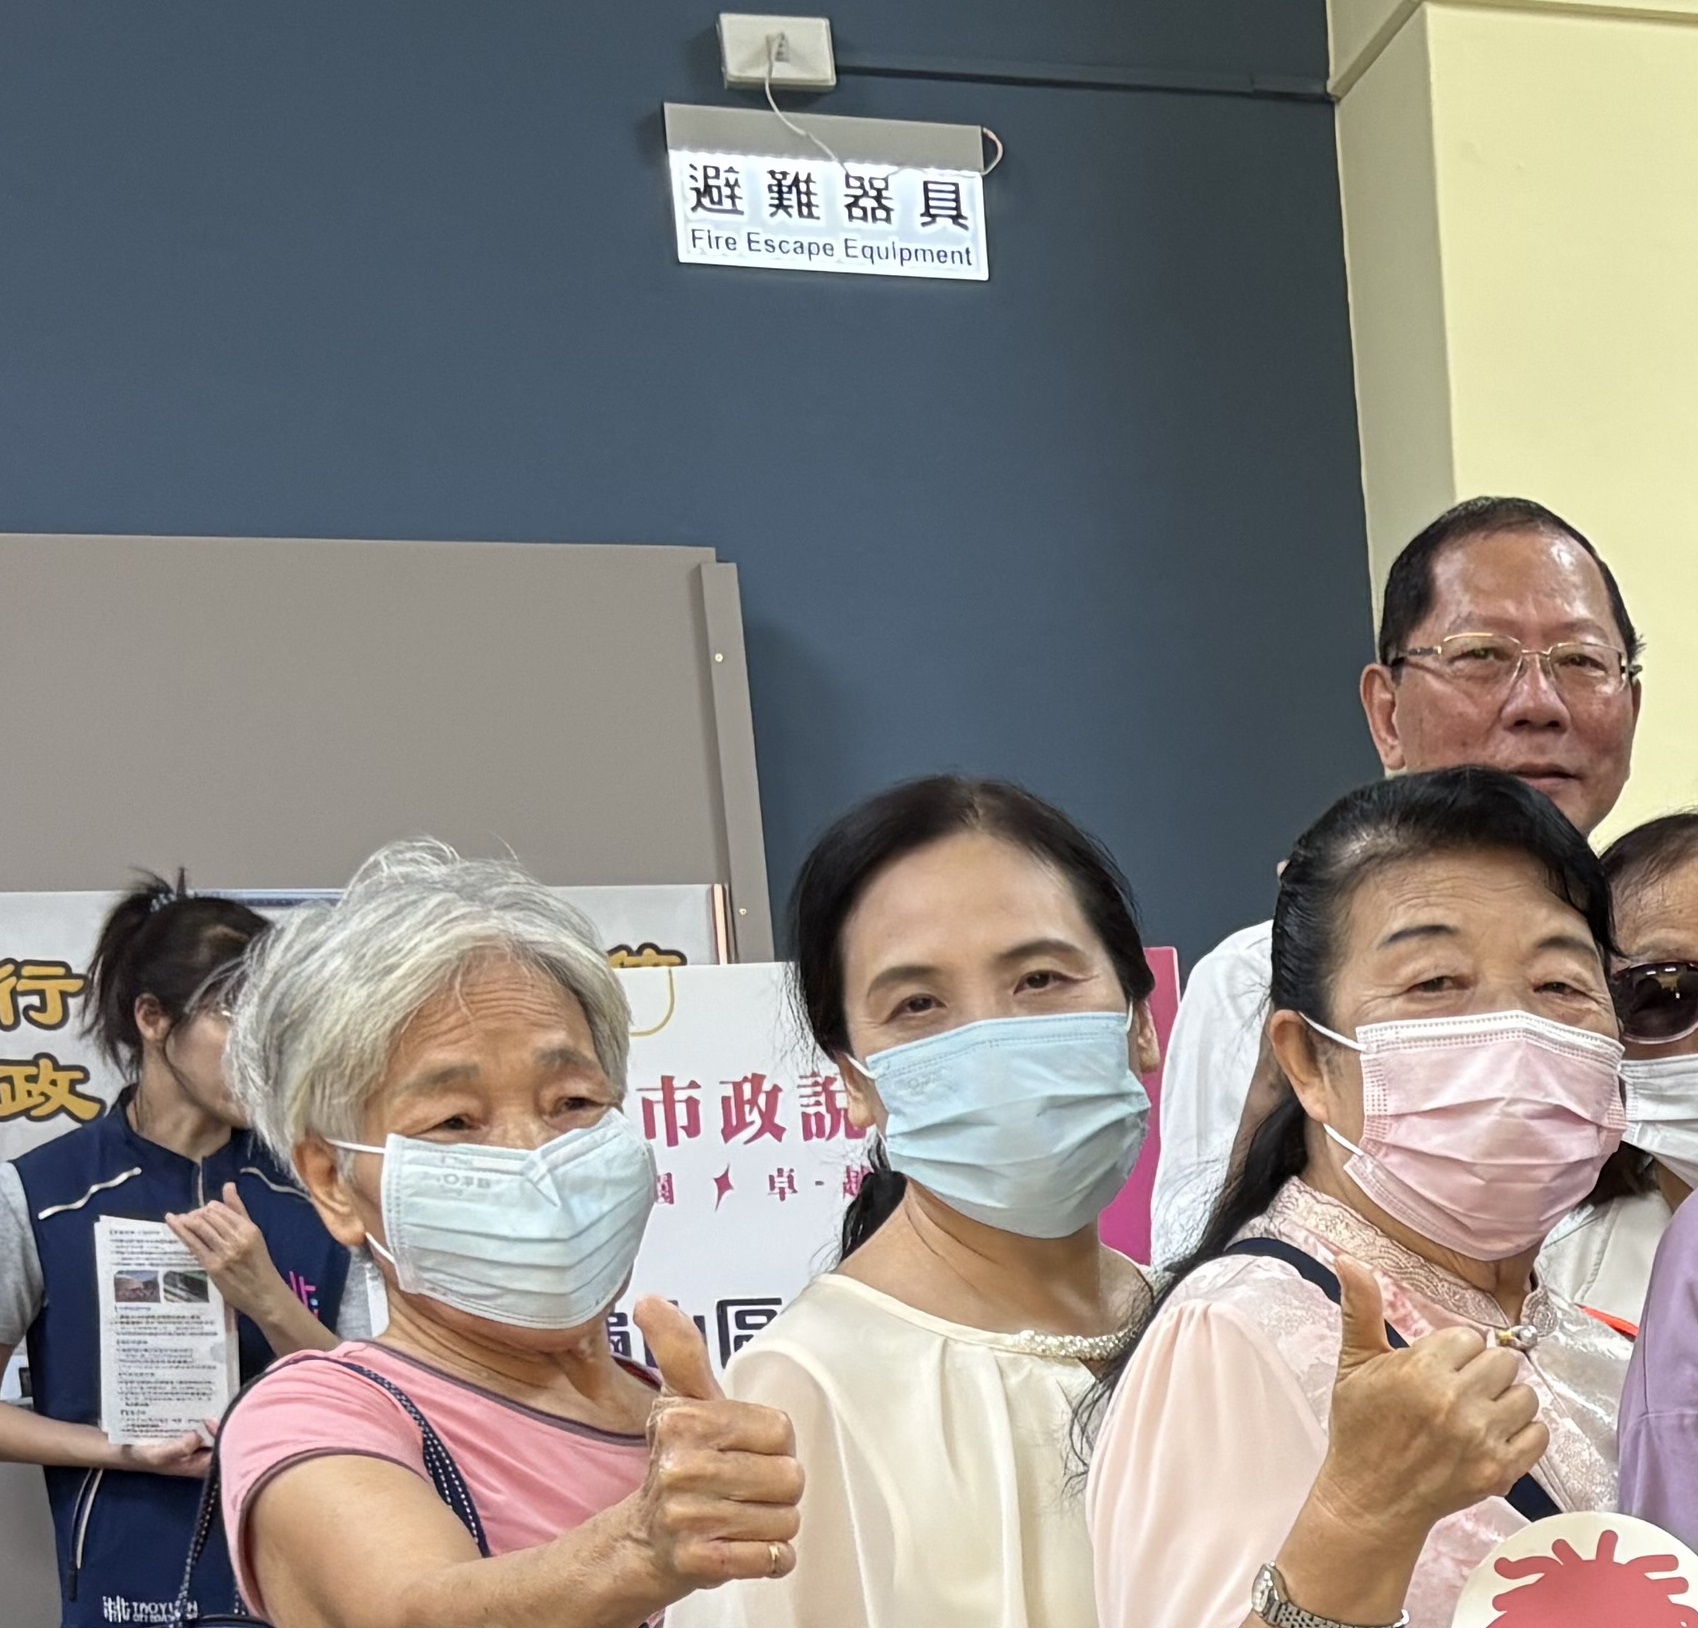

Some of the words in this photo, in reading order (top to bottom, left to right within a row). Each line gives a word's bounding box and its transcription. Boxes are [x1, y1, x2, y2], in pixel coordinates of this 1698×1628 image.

[688, 162, 969, 232] 避難器具
[691, 228, 738, 252] Fire
[746, 231, 836, 261] Escape
[844, 237, 973, 267] Equipment
